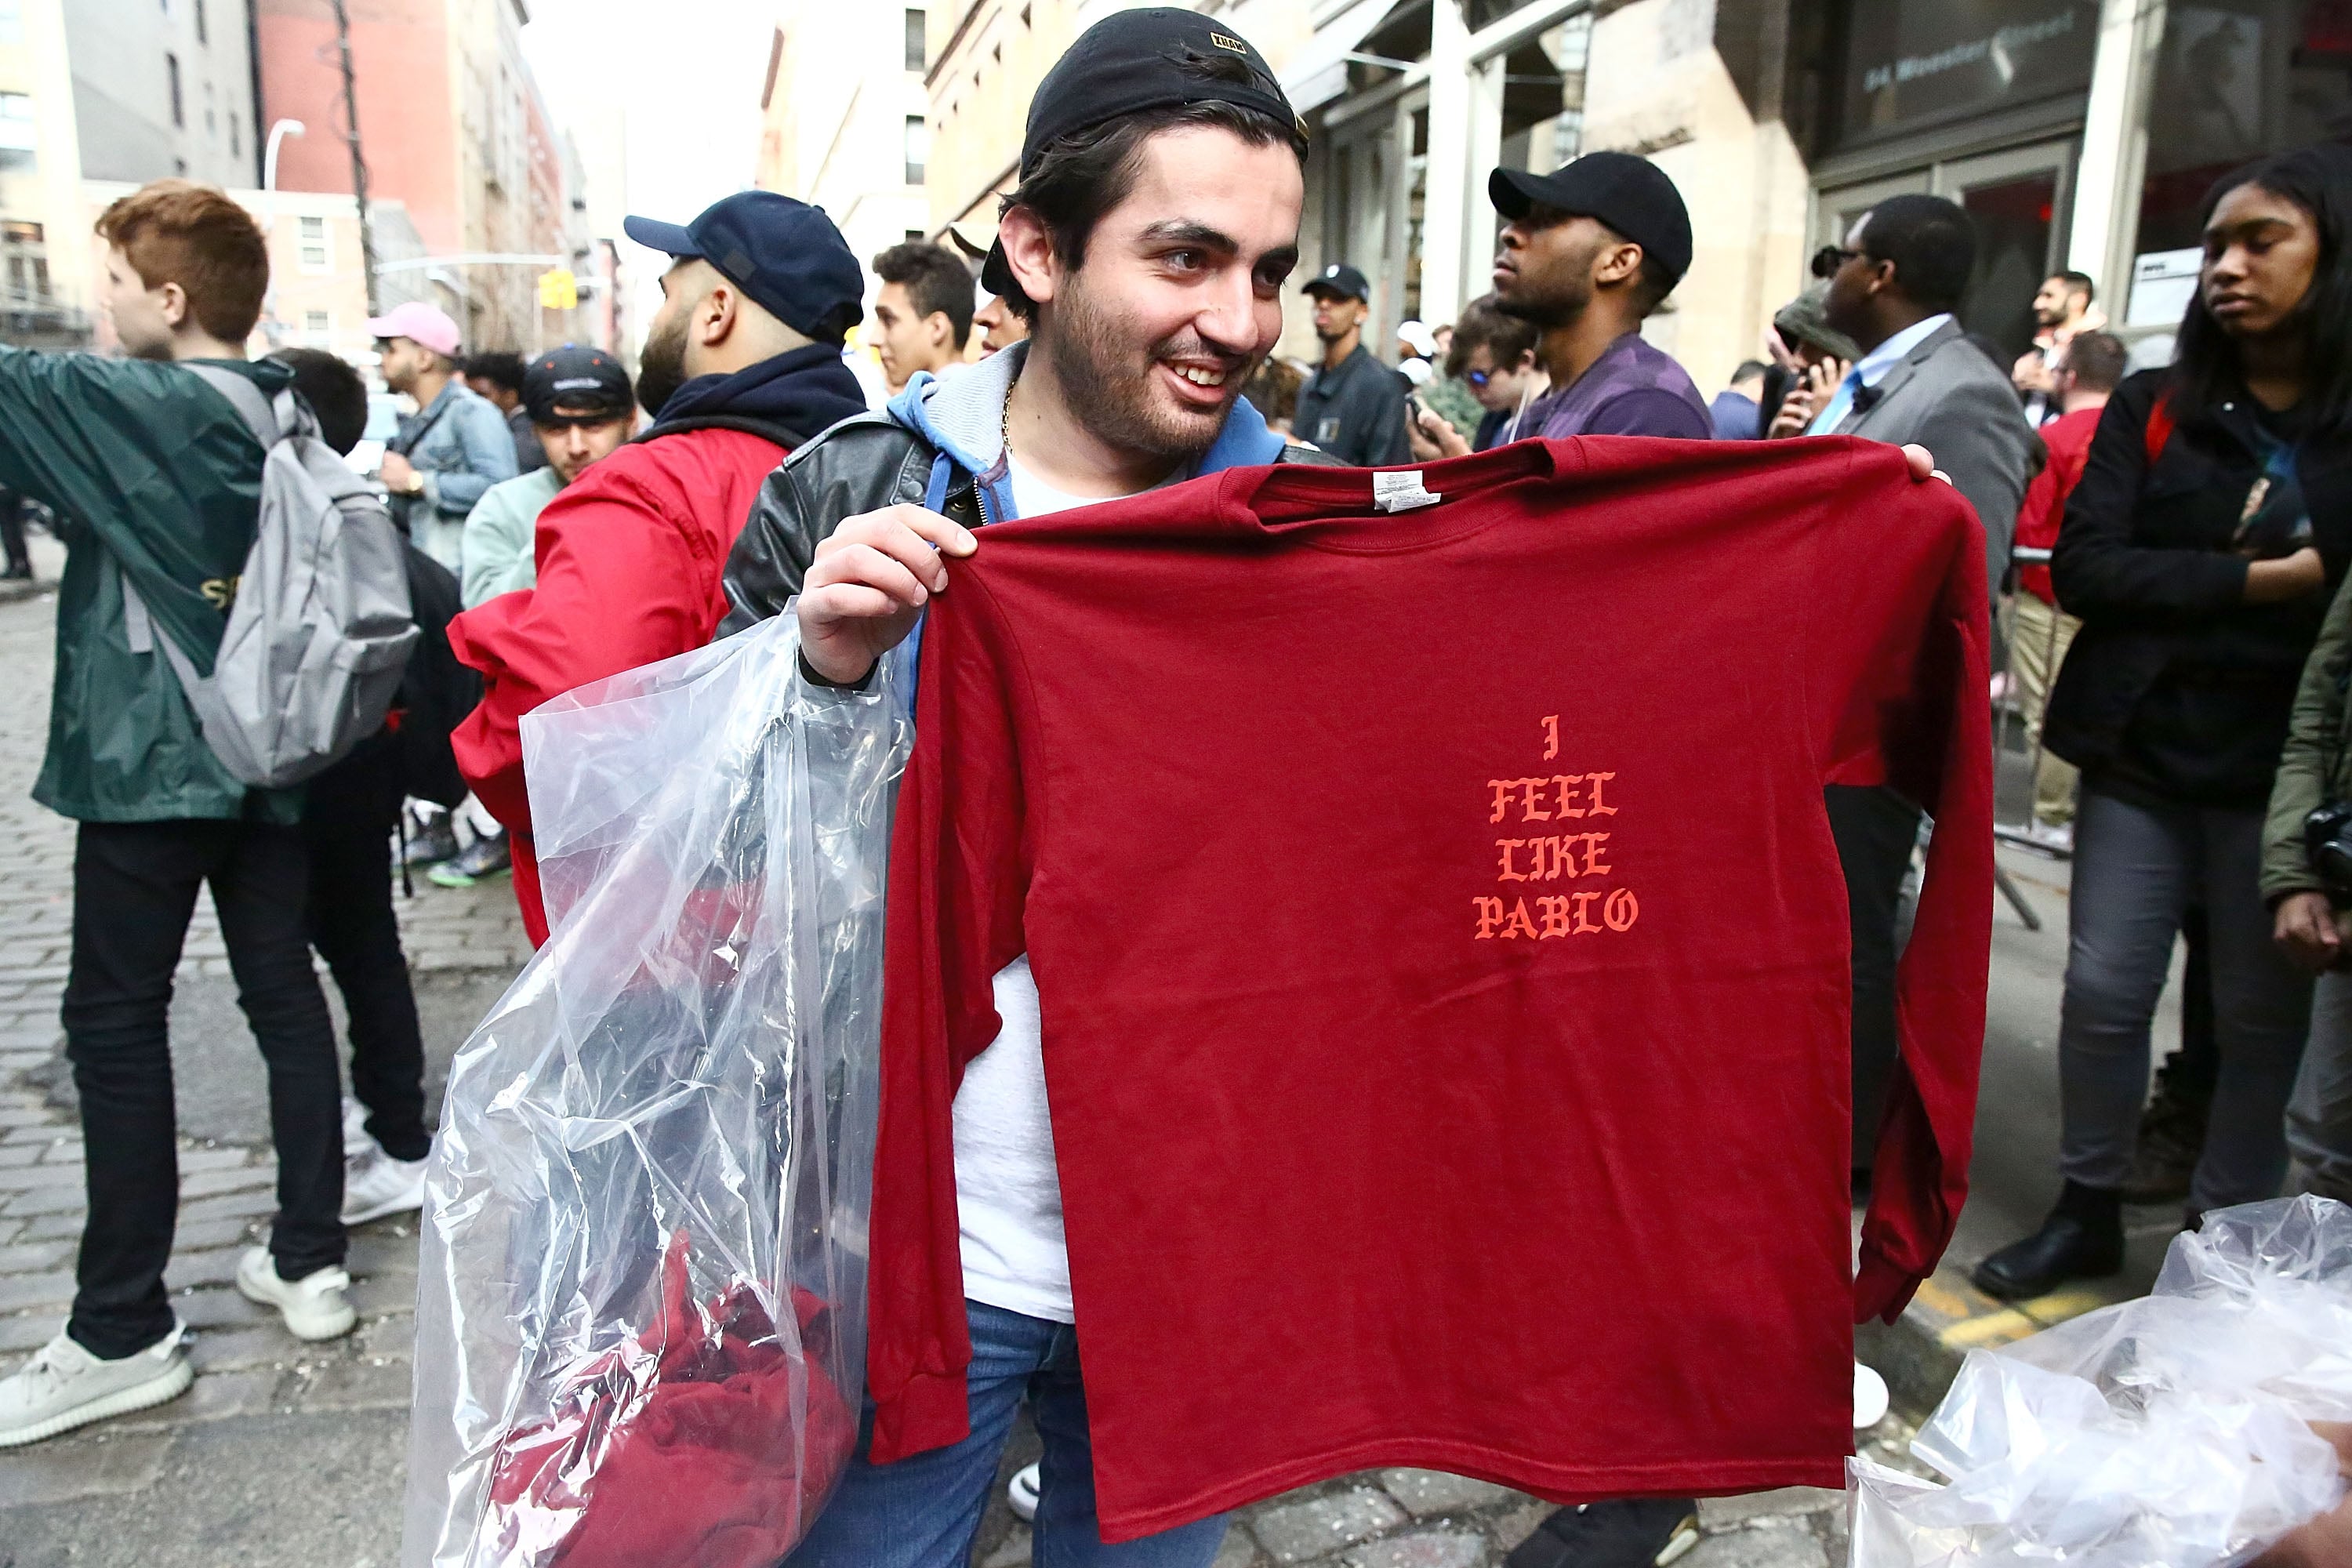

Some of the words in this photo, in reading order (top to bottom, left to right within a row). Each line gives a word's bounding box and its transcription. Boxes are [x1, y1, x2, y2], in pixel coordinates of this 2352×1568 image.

[1541, 714, 1559, 761] I
[1487, 771, 1619, 824] FEEL
[1495, 832, 1612, 882] LIKE
[1472, 887, 1639, 940] PABLO
